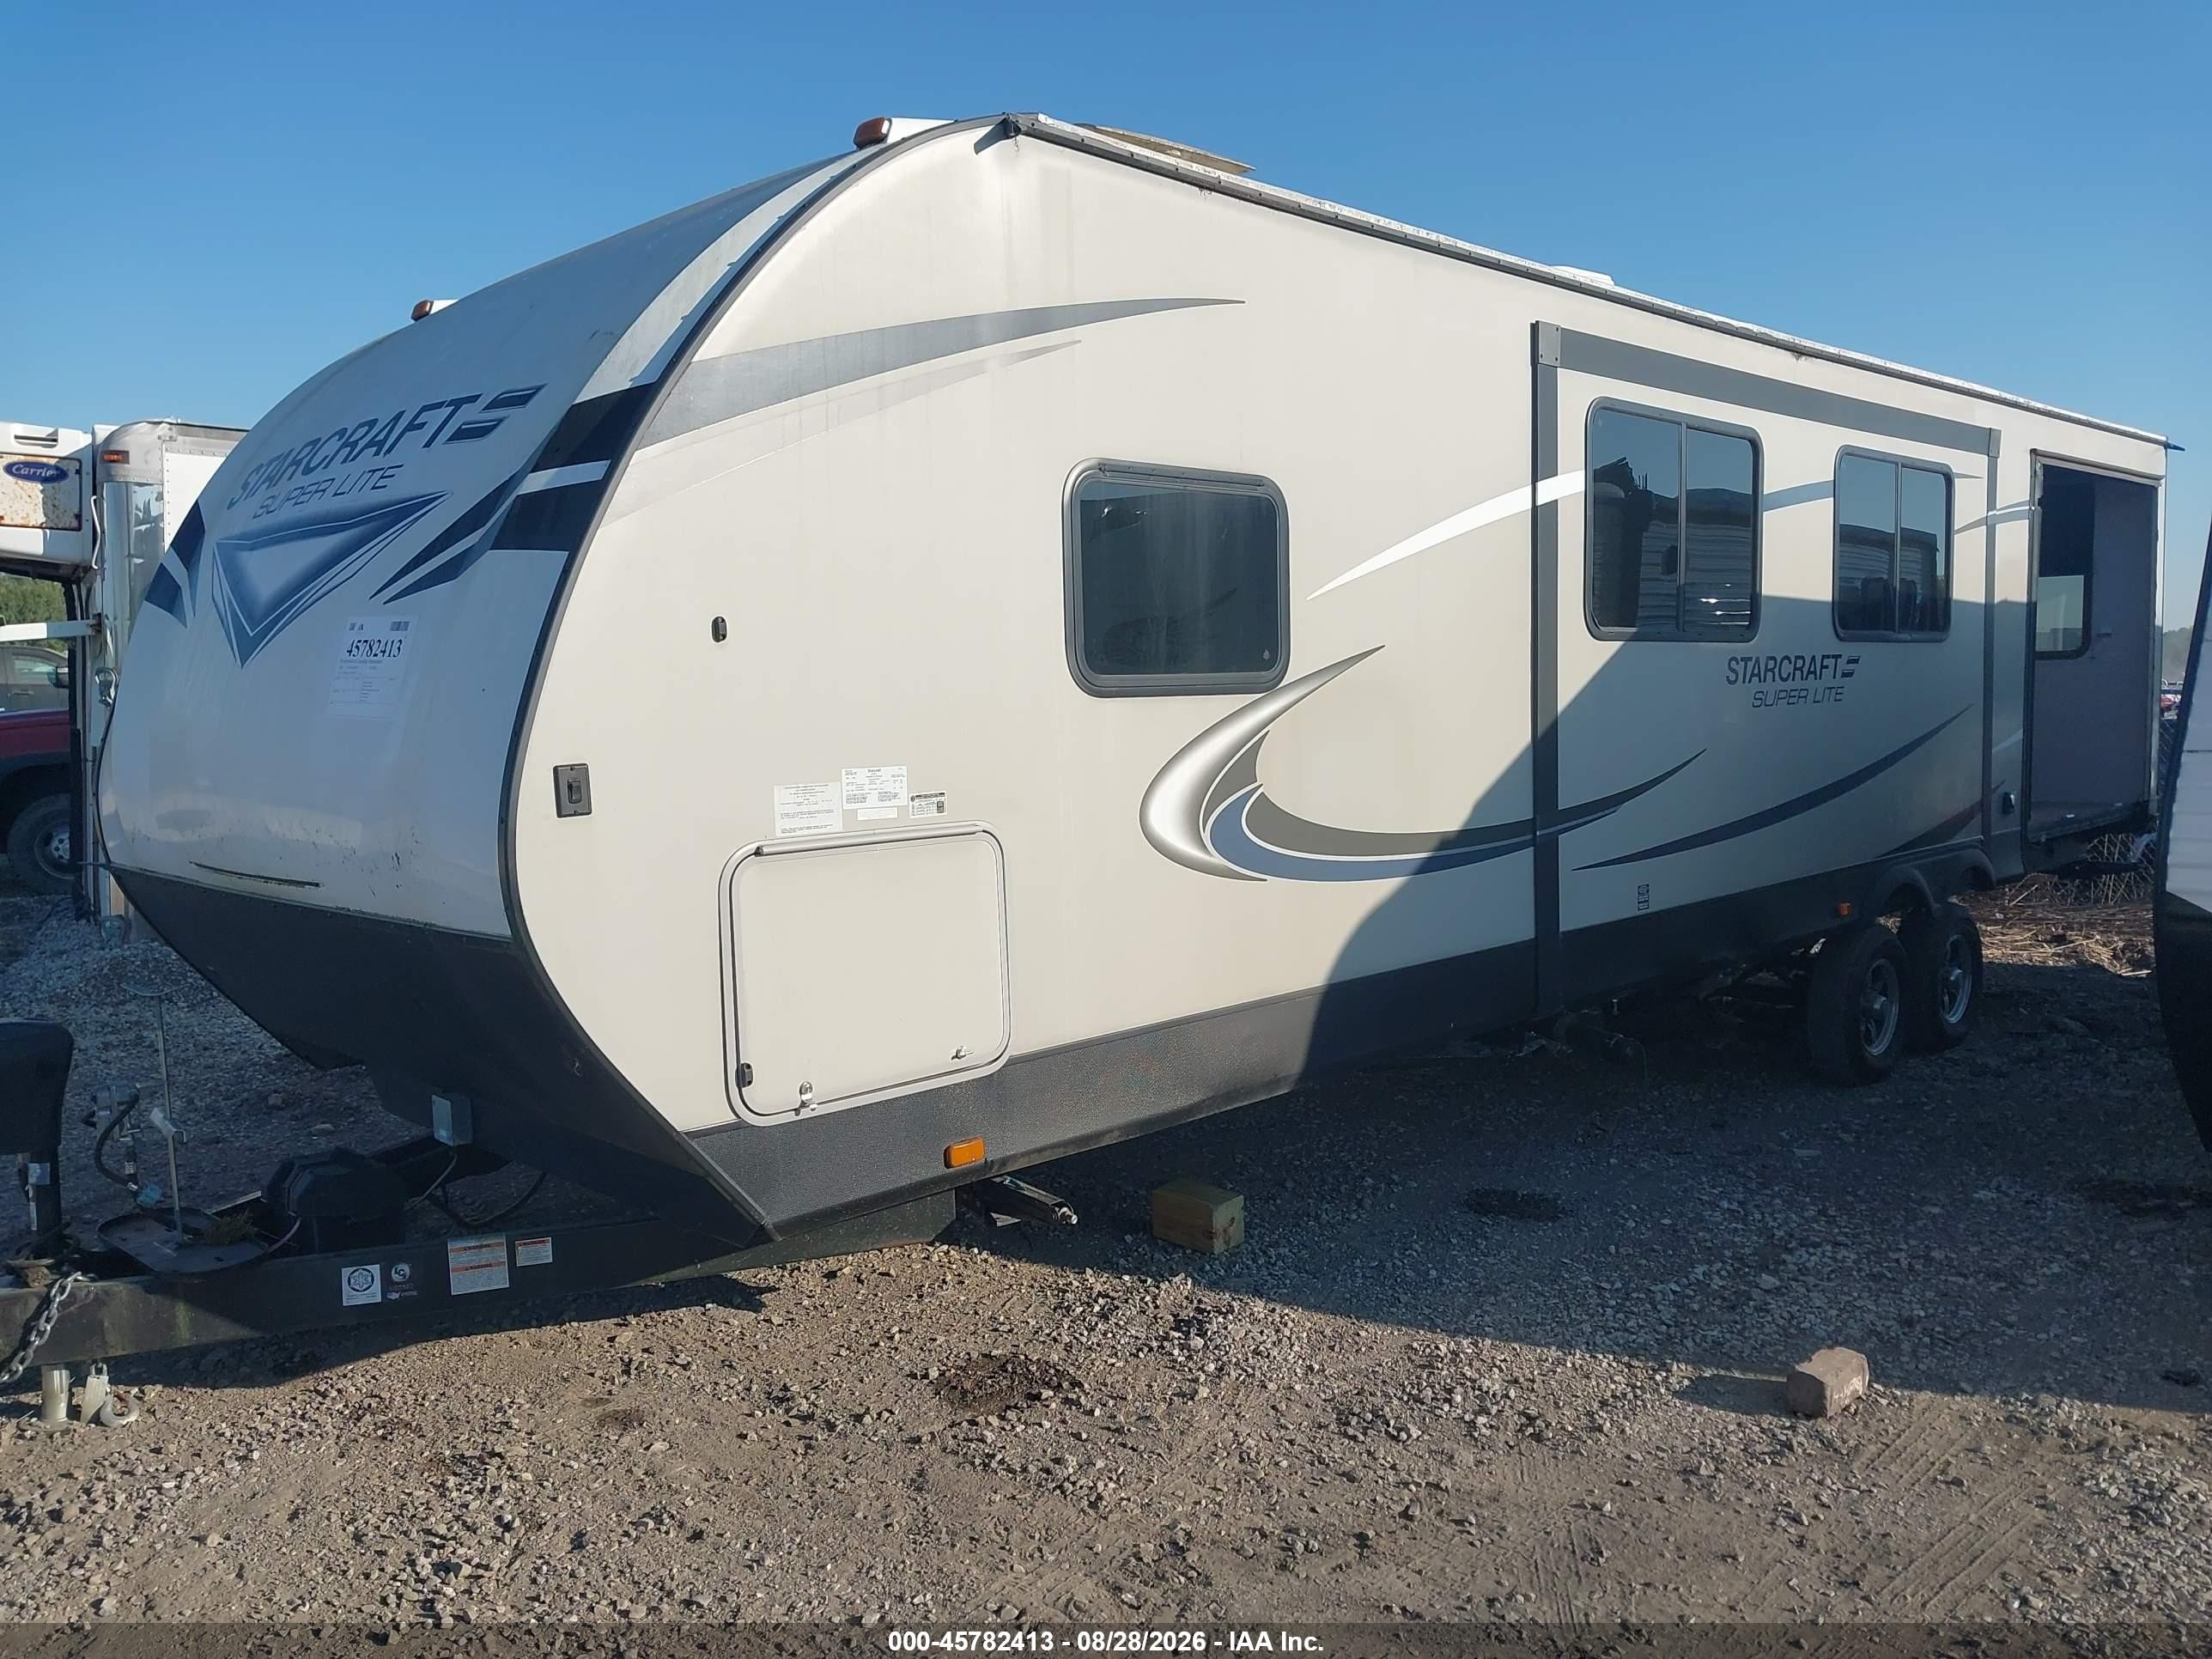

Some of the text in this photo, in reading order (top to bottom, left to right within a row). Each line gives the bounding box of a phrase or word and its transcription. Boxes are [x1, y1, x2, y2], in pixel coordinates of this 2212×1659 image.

[227, 393, 483, 510] STARCRAFT
[252, 464, 404, 520] SUPER LITE
[346, 638, 403, 659] 45782413
[1725, 653, 1843, 685] STARCRAFT
[1752, 686, 1844, 708] SUPER LITE
